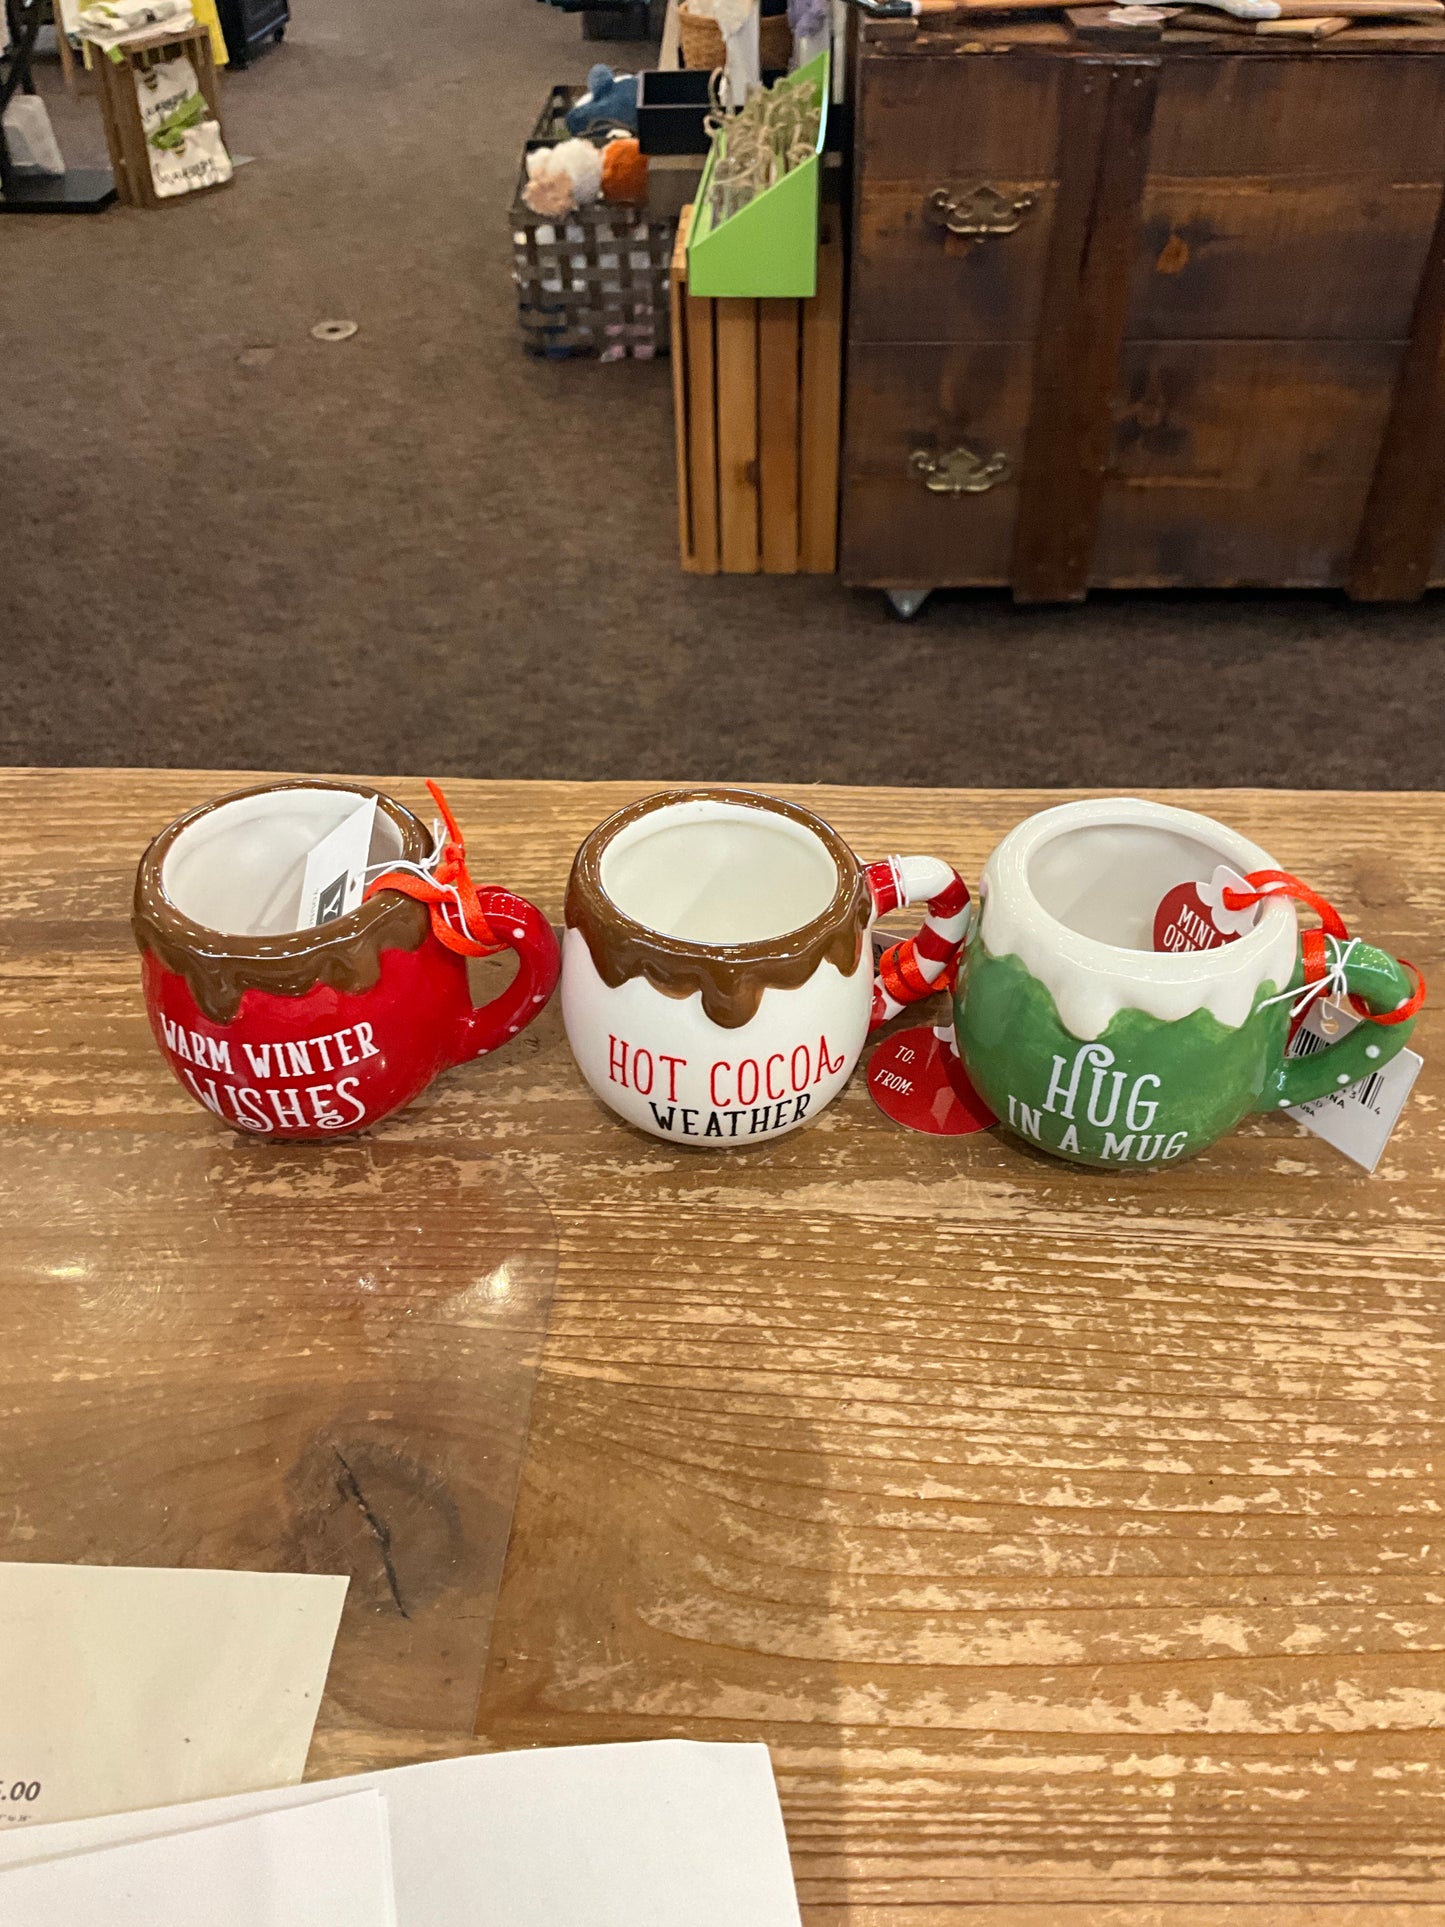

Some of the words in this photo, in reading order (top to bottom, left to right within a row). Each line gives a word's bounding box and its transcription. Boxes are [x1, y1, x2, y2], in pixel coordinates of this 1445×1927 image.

[1177, 904, 1216, 951] MINI
[159, 1012, 235, 1075] WARM
[242, 1021, 381, 1079] WINTER
[608, 1034, 688, 1103] HOT
[709, 1034, 846, 1108] COCOA
[894, 1045, 916, 1065] TO:
[184, 1068, 367, 1133] WISHES
[648, 1093, 812, 1138] WEATHER
[874, 1069, 915, 1097] FROM:
[1042, 1043, 1161, 1132] HUG
[1007, 1094, 1043, 1141] IN
[1056, 1124, 1081, 1155] A
[1099, 1130, 1189, 1163] MUG
